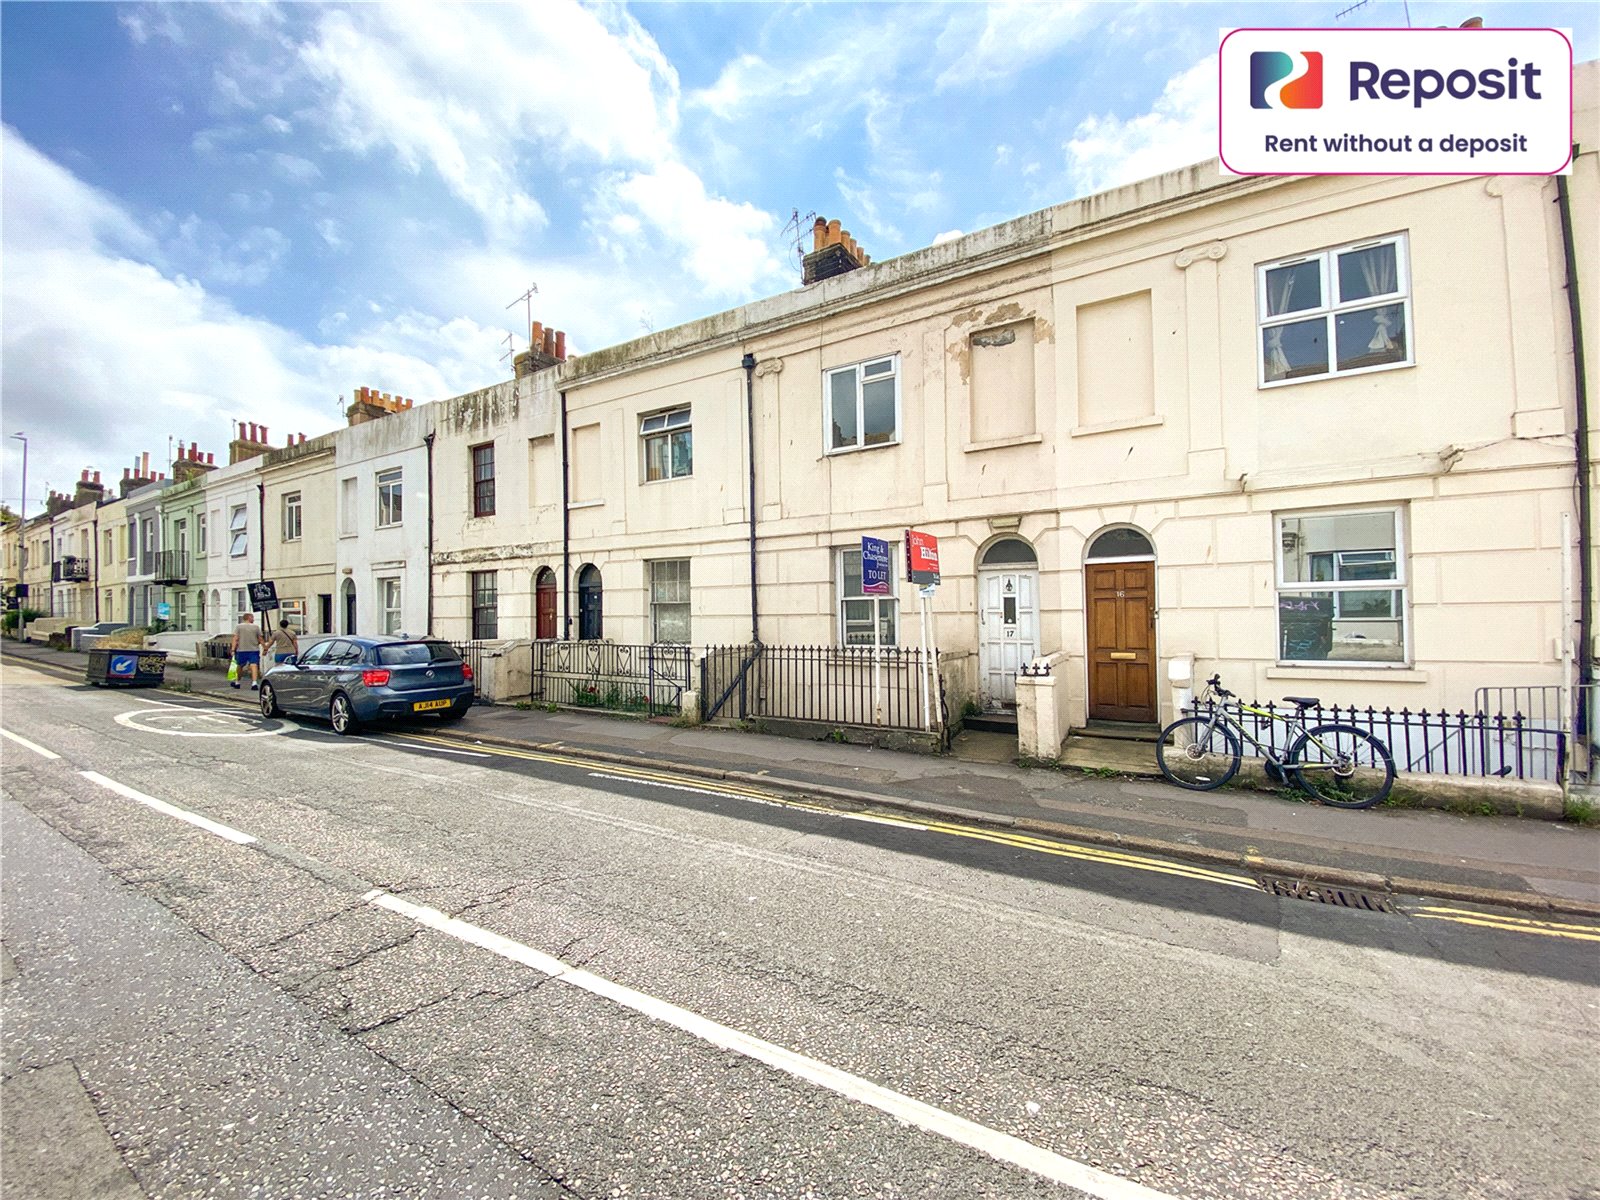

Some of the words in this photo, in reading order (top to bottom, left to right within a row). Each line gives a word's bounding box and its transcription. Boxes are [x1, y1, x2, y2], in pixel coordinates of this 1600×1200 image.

[867, 541, 880, 554] King
[868, 569, 877, 579] TO
[878, 570, 887, 580] LET
[1116, 590, 1125, 598] 16
